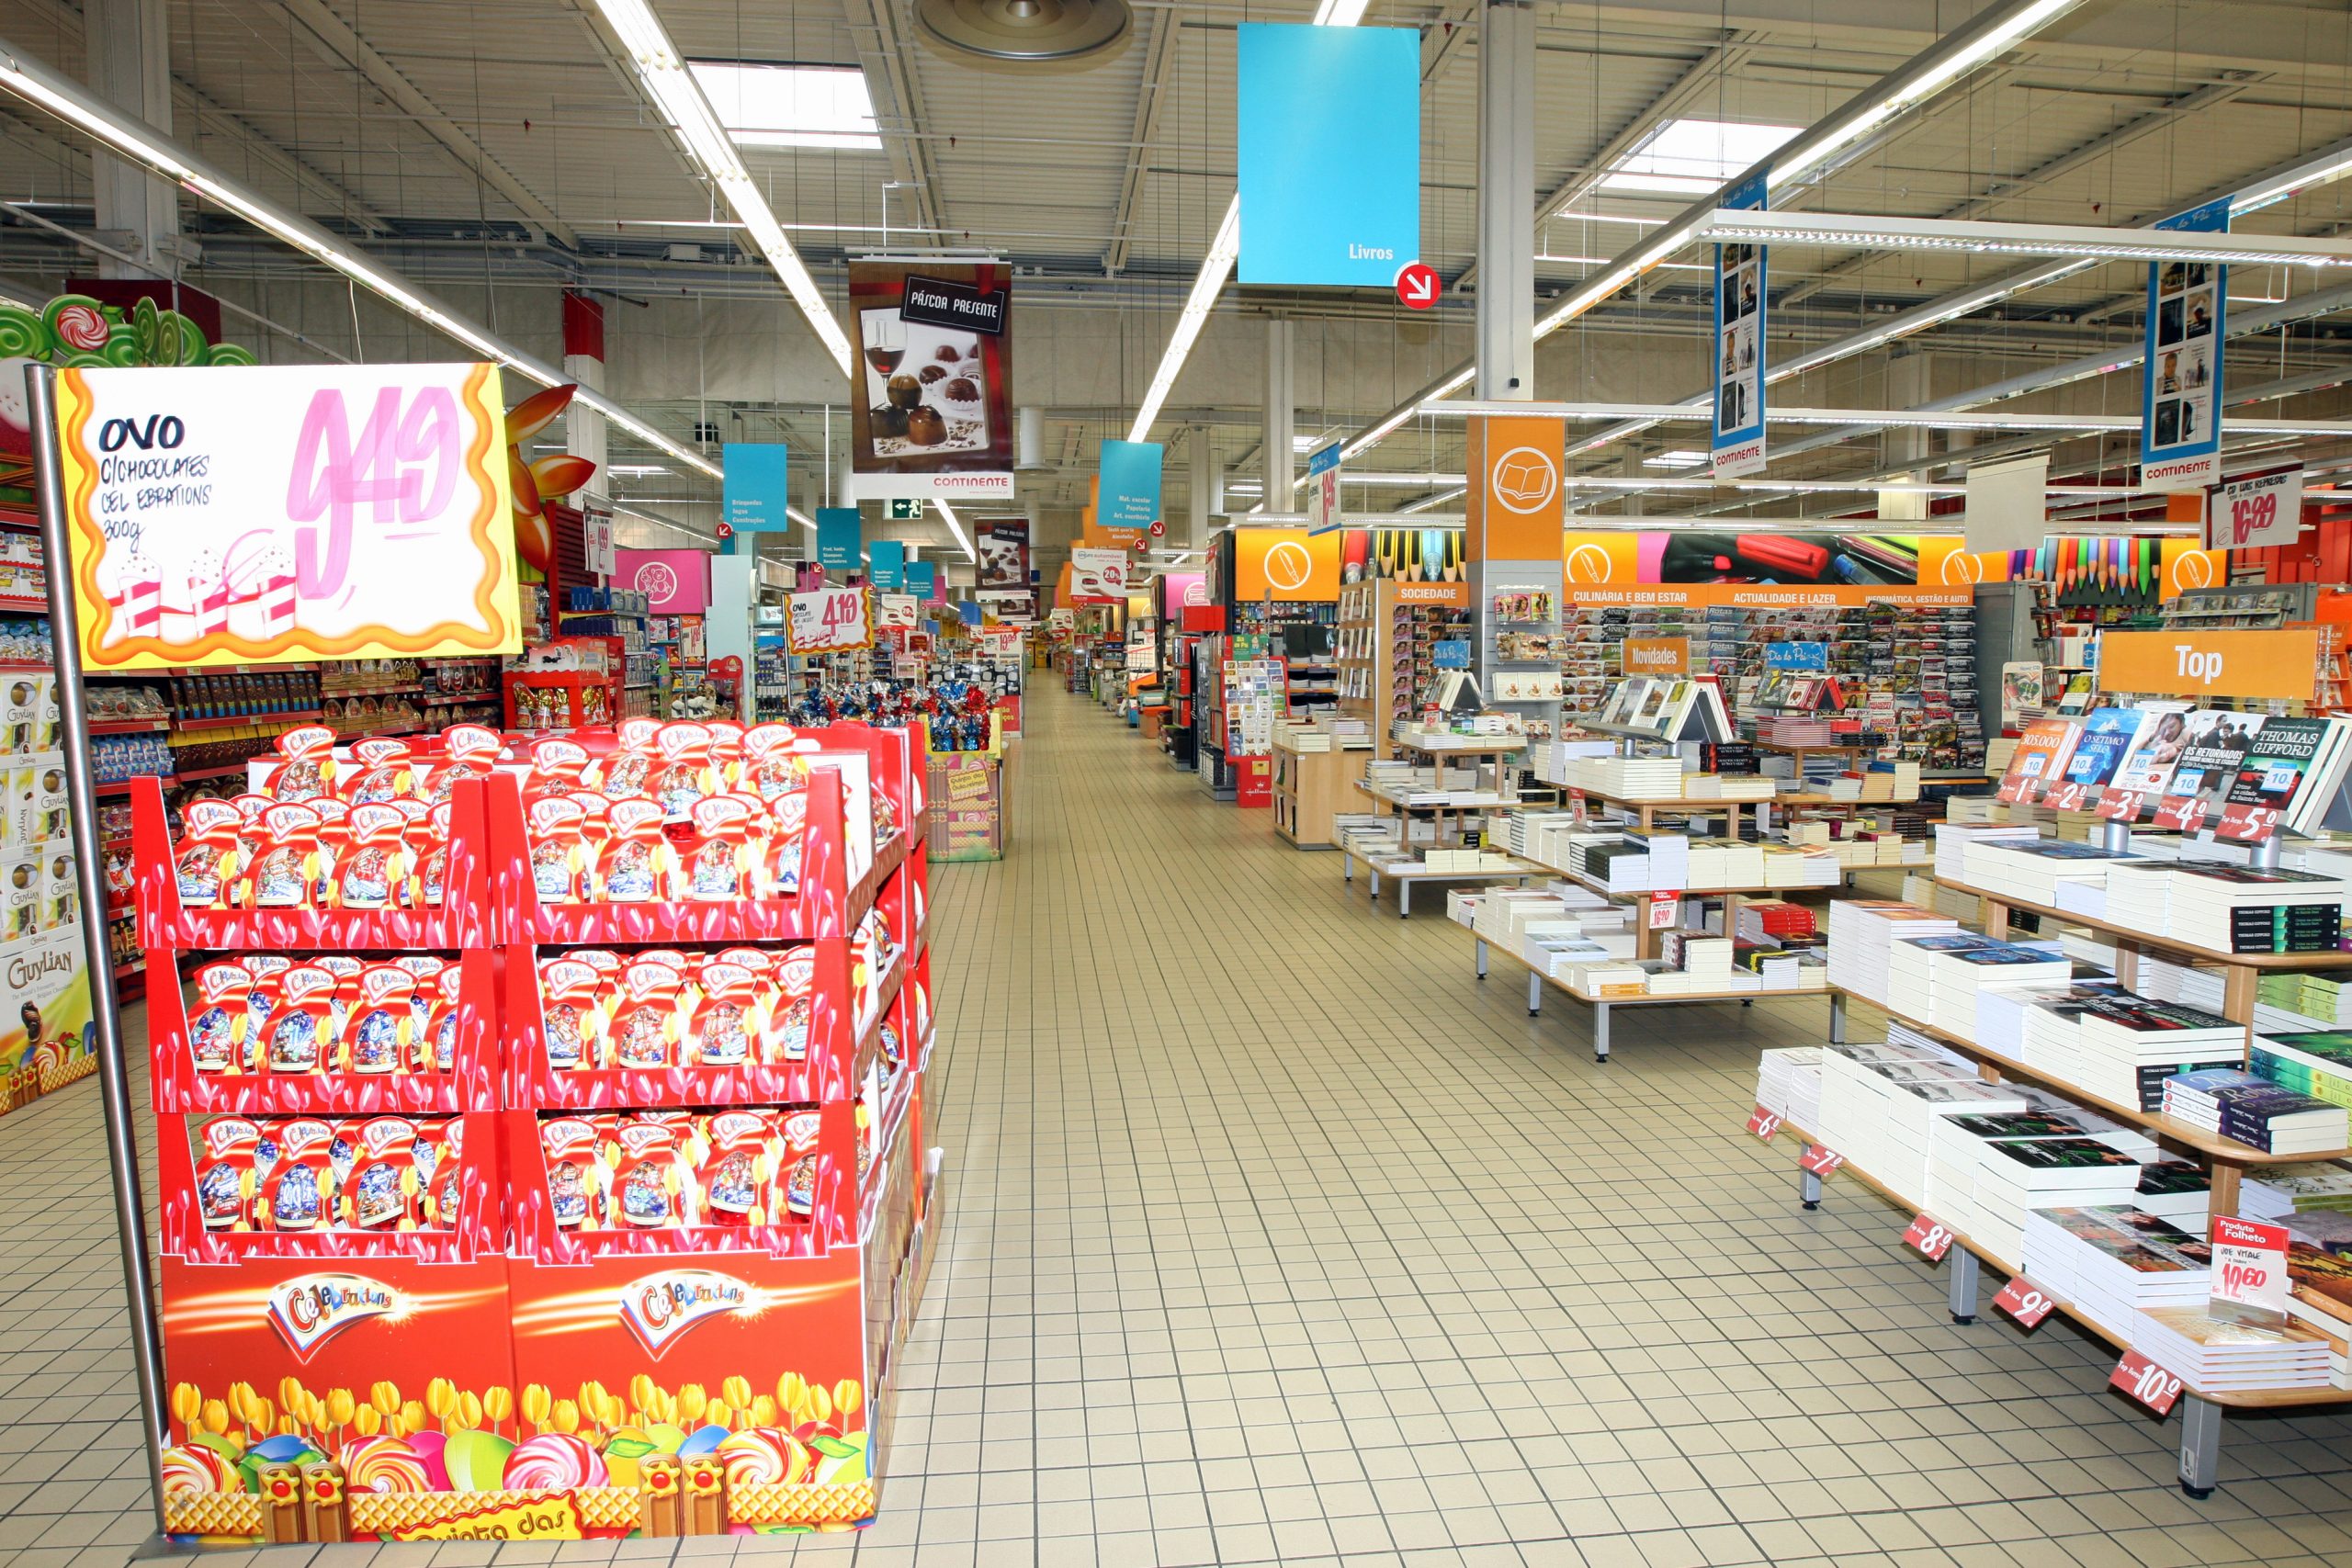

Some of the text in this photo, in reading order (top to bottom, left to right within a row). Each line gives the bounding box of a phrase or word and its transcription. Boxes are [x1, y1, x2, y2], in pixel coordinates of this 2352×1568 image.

[1349, 243, 1394, 260] Livros
[911, 289, 999, 318] PÁSCOA PRESENTE
[99, 414, 185, 452] OVO
[1716, 446, 1760, 466] CONTINENTE
[2146, 460, 2211, 479] CONTINENTE
[933, 478, 1008, 487] CONTINENTE
[1401, 588, 1456, 599] SOCIEDADE
[1574, 590, 1688, 603] CULINÁRIA E BEM ESTAR
[1734, 592, 1837, 604] ACTUALIDADE E LAZER
[1916, 594, 1942, 604] GESTÃO
[1944, 595, 1949, 604] E
[1950, 595, 1969, 604] AUTO
[1633, 647, 1677, 664] Novidades
[2175, 645, 2223, 684] Top
[2021, 734, 2060, 749] 305.000
[2259, 730, 2319, 745] THOMAS
[2185, 746, 2245, 761] OS RETORNADOS
[2253, 742, 2313, 757] GIFFORD
[2220, 1220, 2255, 1233] Produto
[2225, 1228, 2267, 1244] Folheto
[2221, 1247, 2262, 1259] JOE VITALE
[289, 1280, 392, 1333] Celebrations
[643, 1280, 747, 1332] Celebrations
[517, 1510, 566, 1536] das
